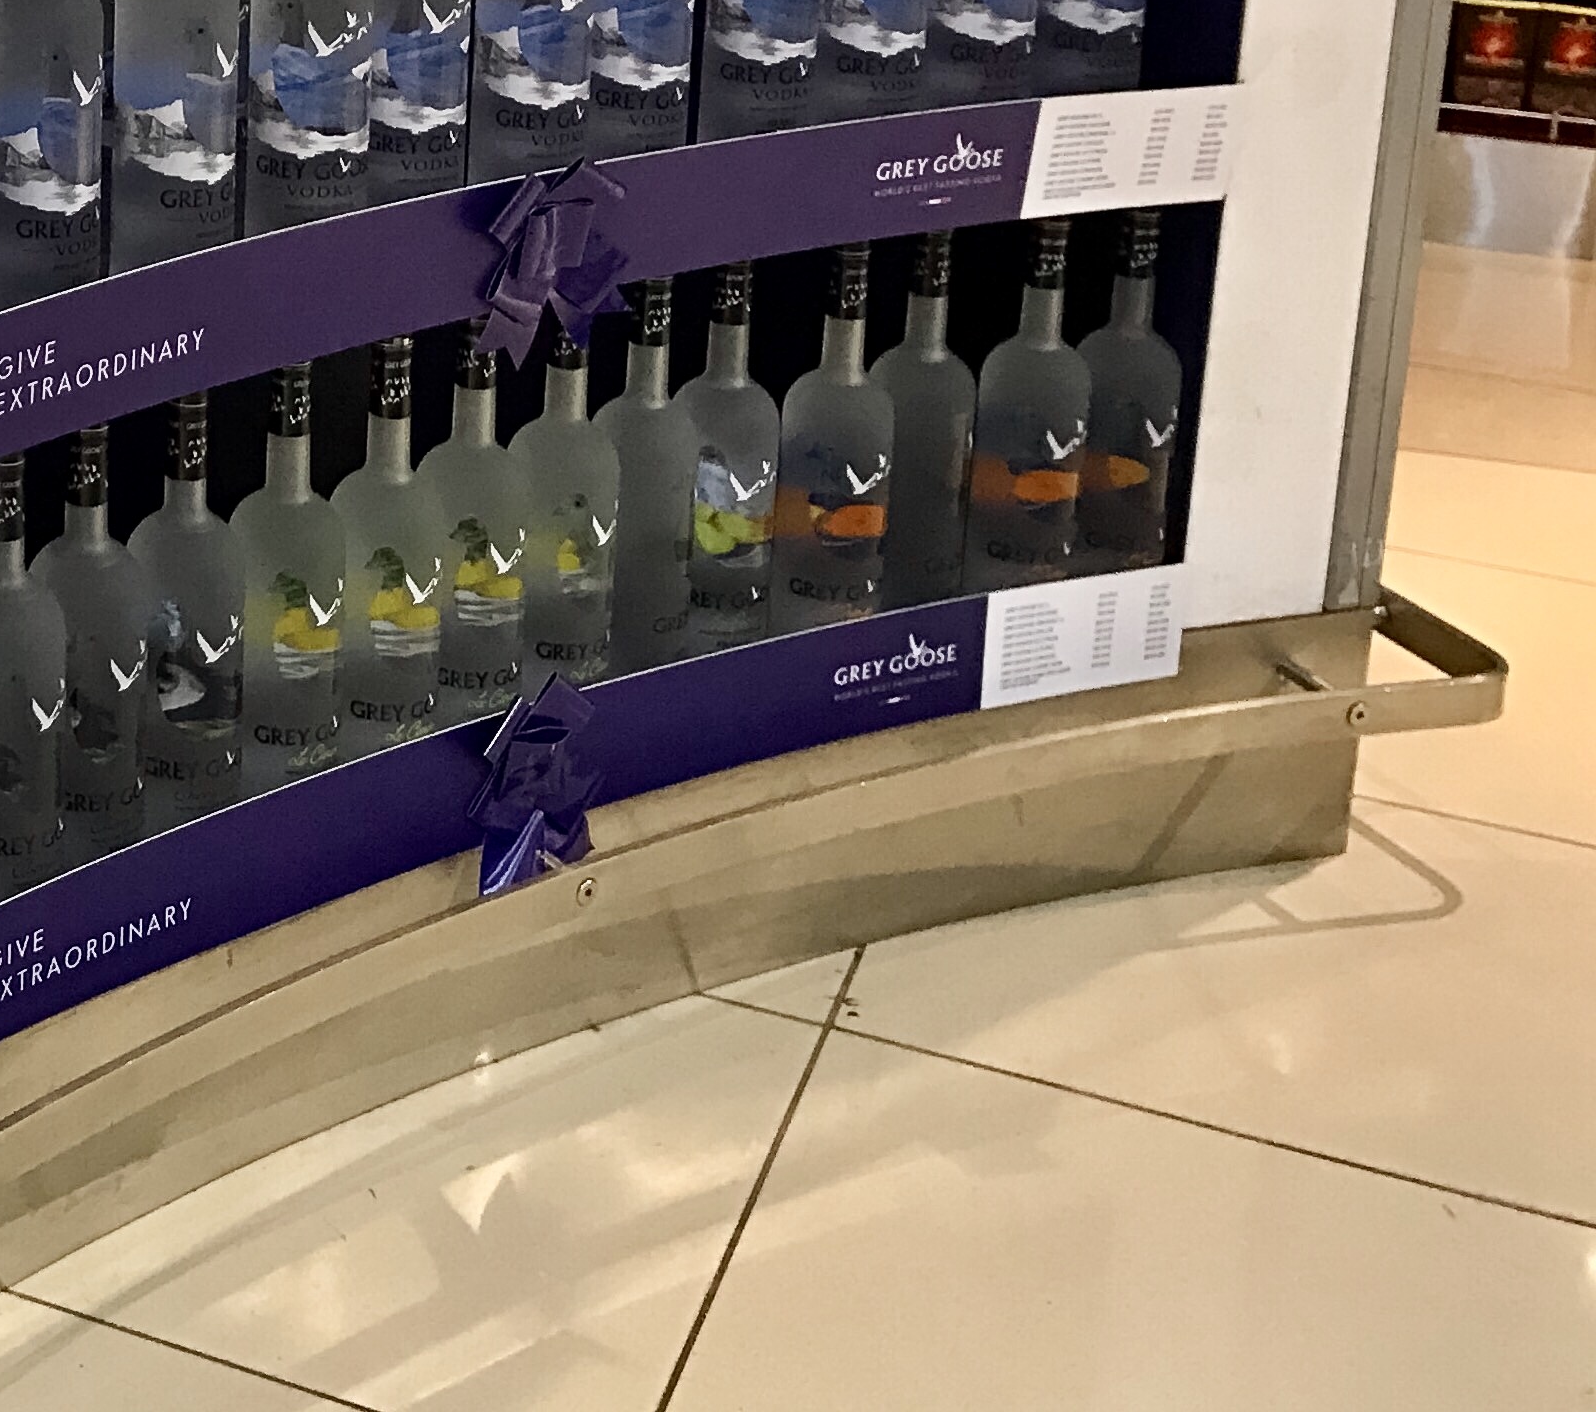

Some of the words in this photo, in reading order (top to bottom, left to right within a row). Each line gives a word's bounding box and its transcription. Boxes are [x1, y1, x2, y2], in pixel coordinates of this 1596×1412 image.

[719, 61, 772, 84] GREY
[836, 52, 889, 75] GREY
[595, 89, 649, 110] GREY
[495, 108, 550, 130] GREY
[256, 154, 305, 180] GREY
[876, 157, 930, 181] GREY
[933, 148, 1004, 173] GOOSE
[159, 188, 216, 209] GREY
[15, 219, 74, 239] GREY
[535, 640, 589, 661] GREY
[833, 658, 884, 686] GREY
[889, 643, 958, 674] GOOSE
[437, 666, 489, 689] GREY
[350, 700, 404, 722] GREY
[254, 724, 310, 746] GREY
